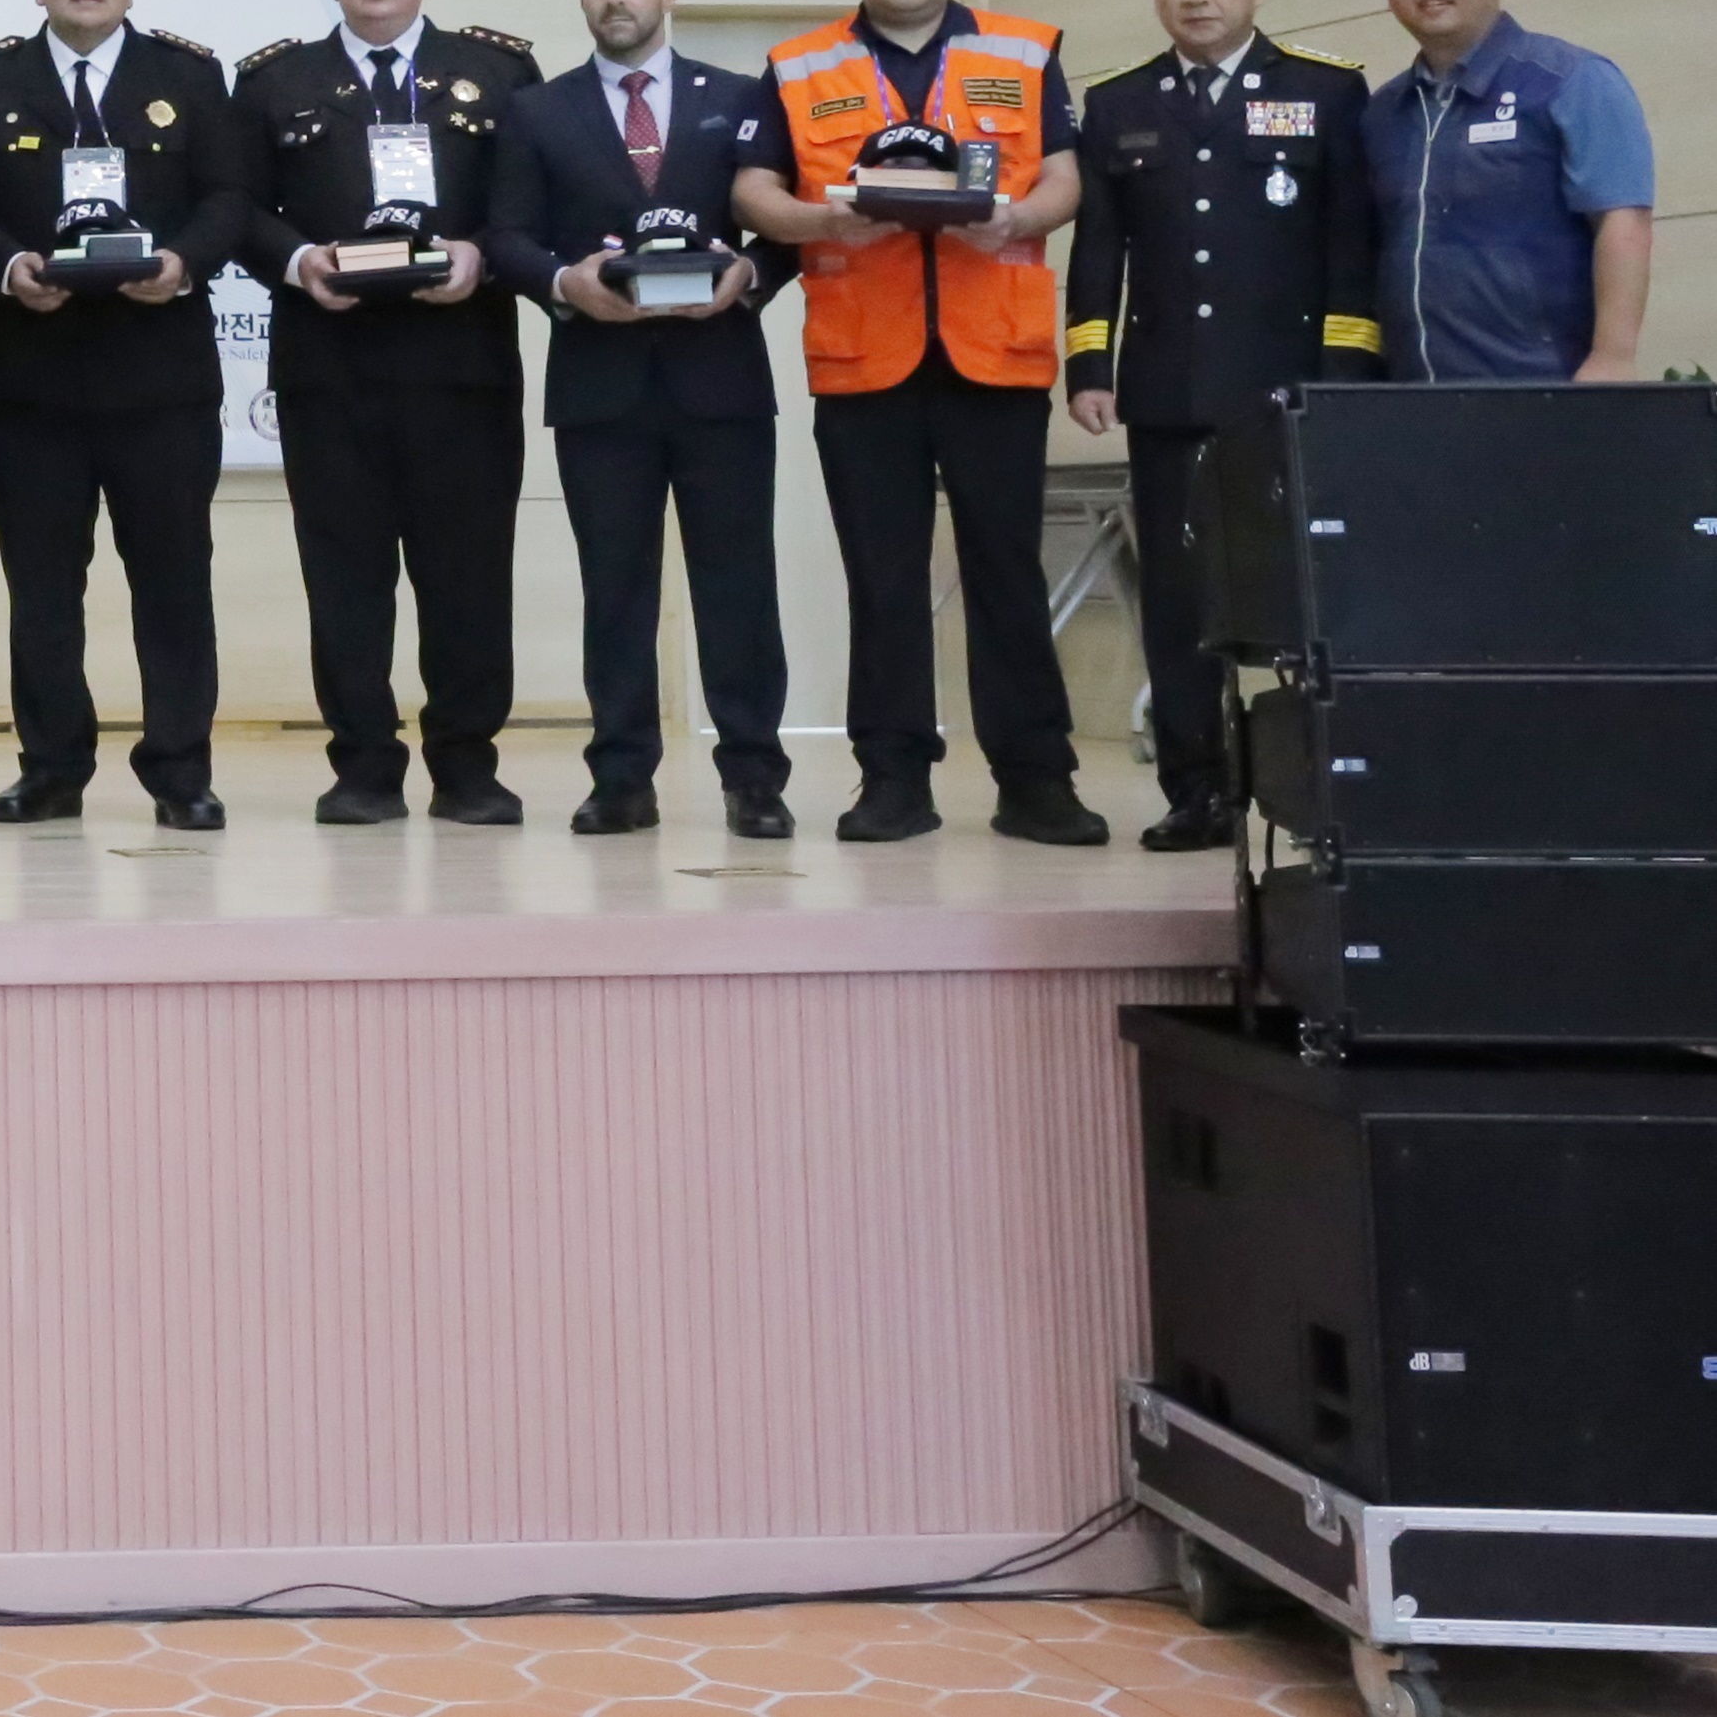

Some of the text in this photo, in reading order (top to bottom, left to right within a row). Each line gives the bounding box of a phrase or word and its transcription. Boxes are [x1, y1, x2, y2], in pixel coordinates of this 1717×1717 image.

[878, 127, 944, 152] GFSA
[56, 203, 108, 234] GFSA
[364, 206, 422, 230] GFSA
[636, 208, 699, 233] GFSA
[1408, 1351, 1431, 1371] dB
